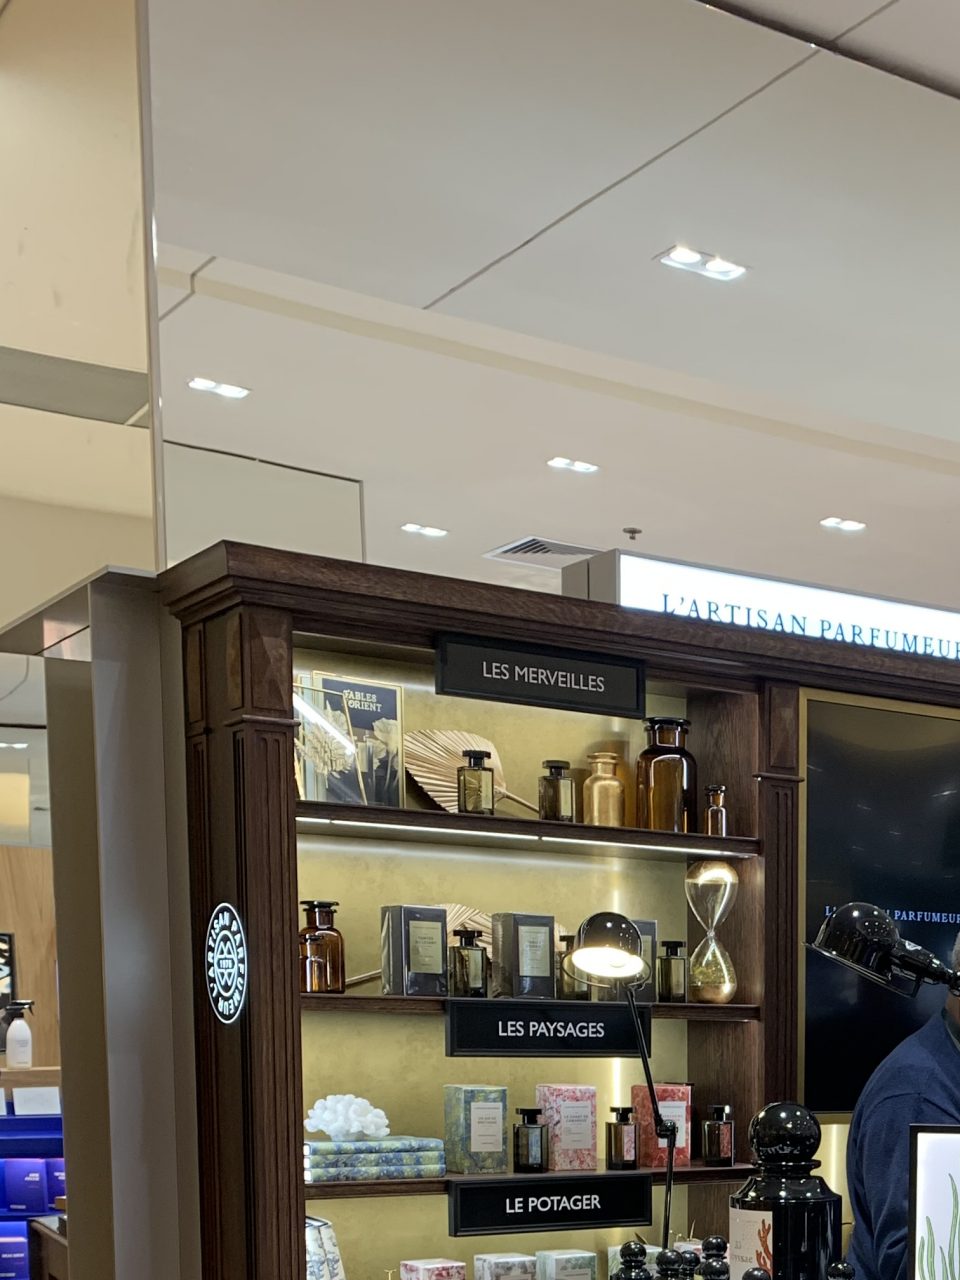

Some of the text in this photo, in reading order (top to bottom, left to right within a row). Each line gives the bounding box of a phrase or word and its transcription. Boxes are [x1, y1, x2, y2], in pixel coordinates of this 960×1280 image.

[662, 593, 807, 635] L'ARTISAN
[482, 660, 605, 692] LES MERVEILLES
[498, 1020, 605, 1038] LES PAYSAGES
[505, 1195, 601, 1214] LE POTAGER
